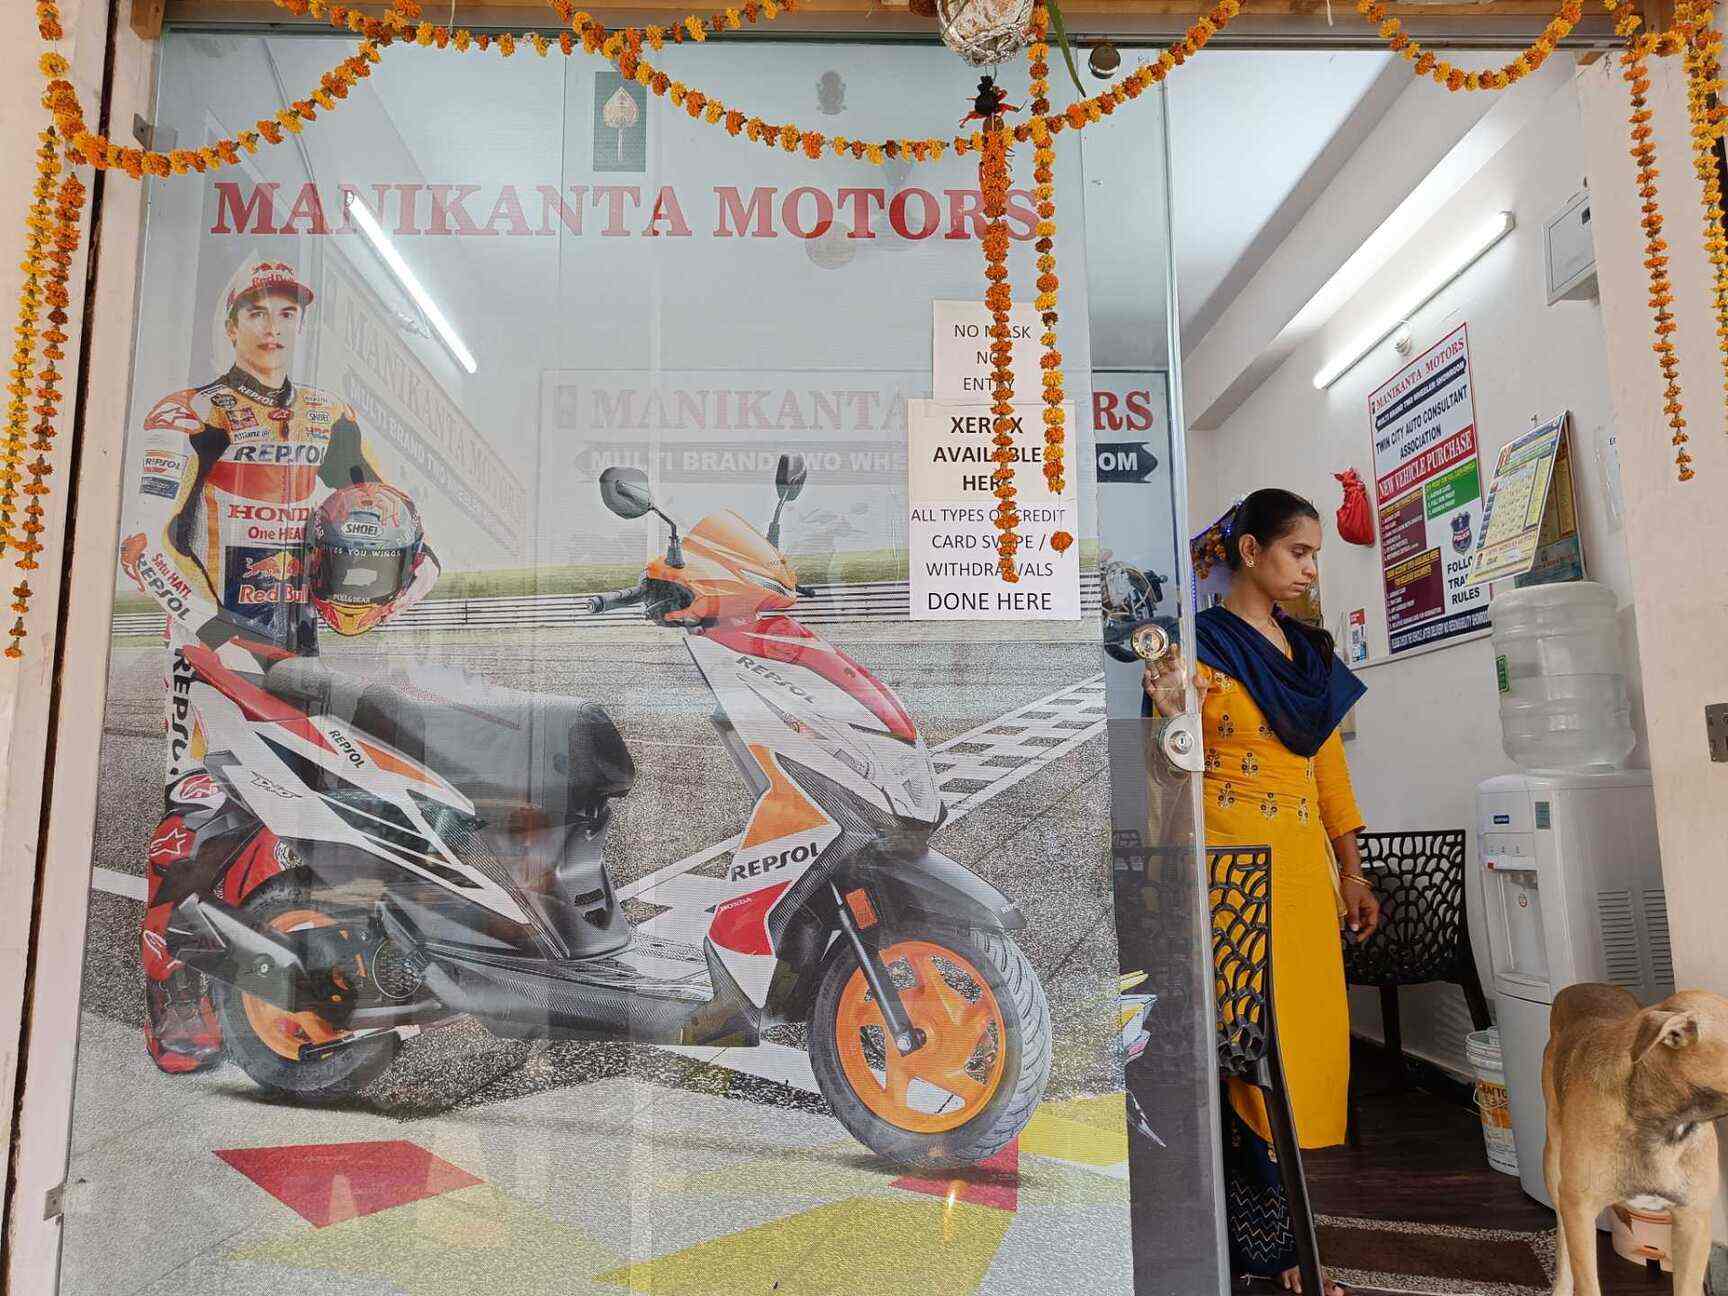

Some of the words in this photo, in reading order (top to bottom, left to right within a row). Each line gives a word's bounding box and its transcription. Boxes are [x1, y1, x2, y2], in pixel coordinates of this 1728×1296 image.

[210, 181, 693, 236] MANIKANTA
[712, 185, 1041, 242] MOTORS
[954, 324, 978, 338] NO
[985, 324, 1031, 339] SK
[1375, 368, 1422, 411] MANIKANTA
[1425, 338, 1464, 374] MOTORS
[963, 377, 1015, 391] ENTY
[591, 386, 908, 430] MANIKANTA
[951, 417, 1023, 434] XERX
[1375, 436, 1391, 454] TWIN
[1391, 426, 1404, 445] CITY
[1405, 415, 1422, 435] AUTO
[1423, 384, 1468, 422] CONSULTANT
[1400, 424, 1442, 458] ASSOCIATION
[933, 446, 1041, 463] AVAILBLE
[1394, 457, 1427, 492] VEHICLE
[1427, 430, 1472, 472] PURCHASE
[963, 475, 1013, 491] HER
[228, 504, 310, 521] HOND
[911, 509, 936, 522] ALL
[941, 509, 984, 522] TYPES
[1014, 509, 1066, 522] CREDIT
[248, 526, 275, 540] One
[279, 527, 305, 540] HEA
[344, 523, 378, 536] SHOEI
[932, 535, 977, 549] CARD
[982, 534, 1034, 549] SPE
[1038, 532, 1046, 551] /
[926, 562, 1053, 577] WITHDRAALS
[1447, 556, 1473, 574] FOLL
[239, 584, 280, 603] Red
[929, 592, 989, 610] DONE
[998, 592, 1052, 610] HERE
[1452, 587, 1480, 605] RULES
[736, 655, 817, 704] REPSOL
[328, 729, 366, 769] REPSOL
[731, 842, 821, 882] REPSOL
